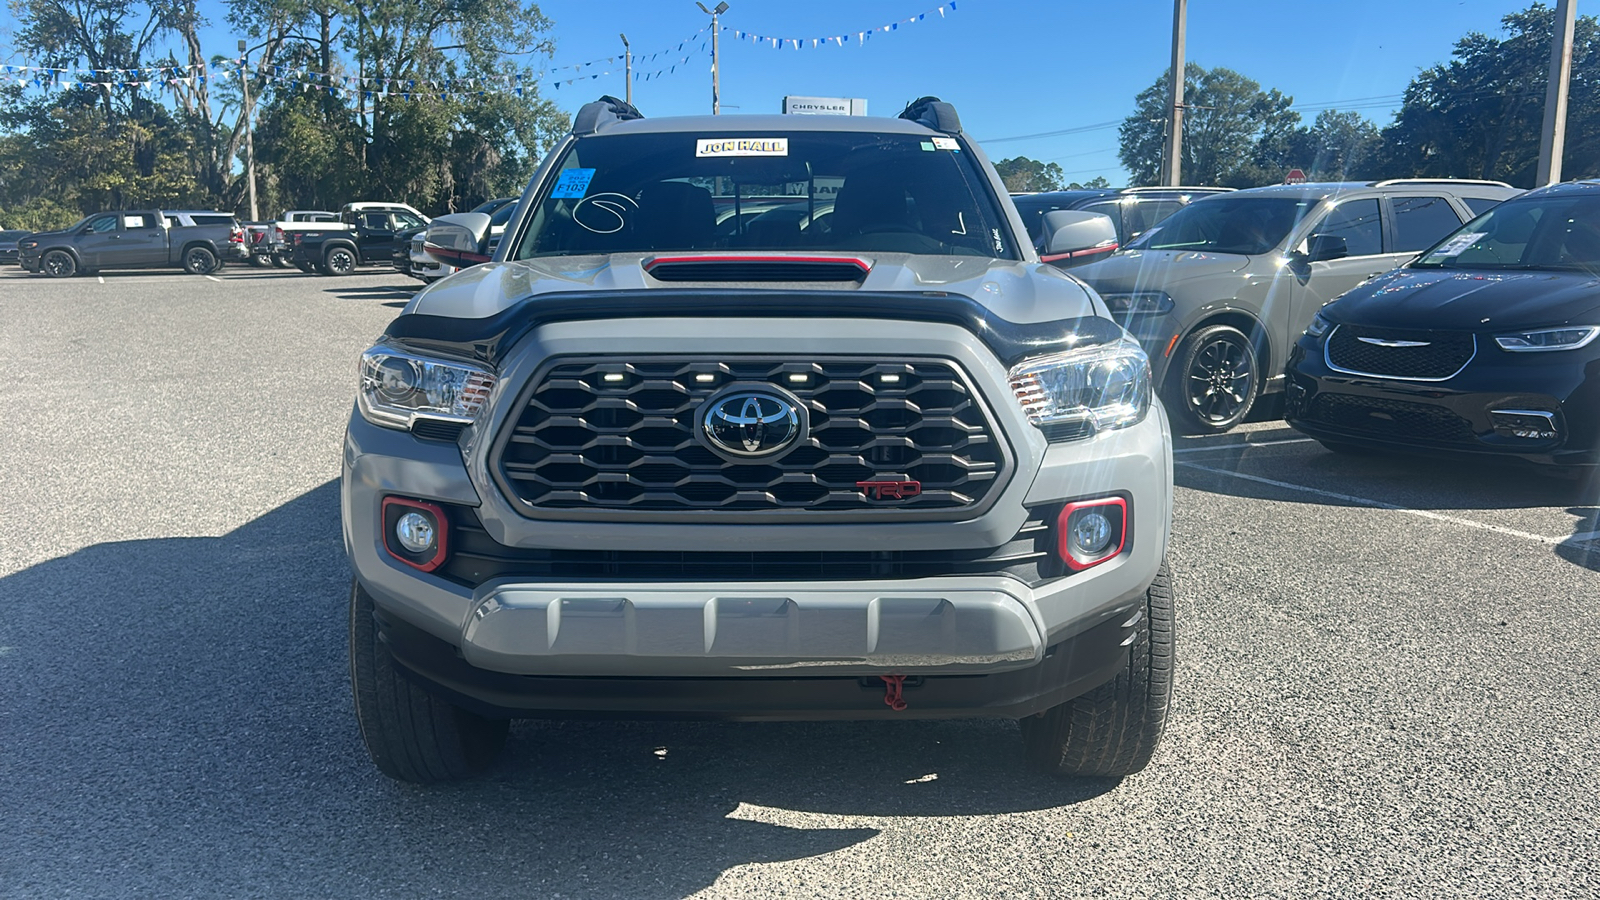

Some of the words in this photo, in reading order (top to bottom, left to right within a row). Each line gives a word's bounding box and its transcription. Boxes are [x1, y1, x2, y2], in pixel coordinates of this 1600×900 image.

[700, 141, 735, 154] JON
[738, 140, 784, 152] HALL
[557, 183, 586, 192] F103
[856, 481, 921, 500] TRD
